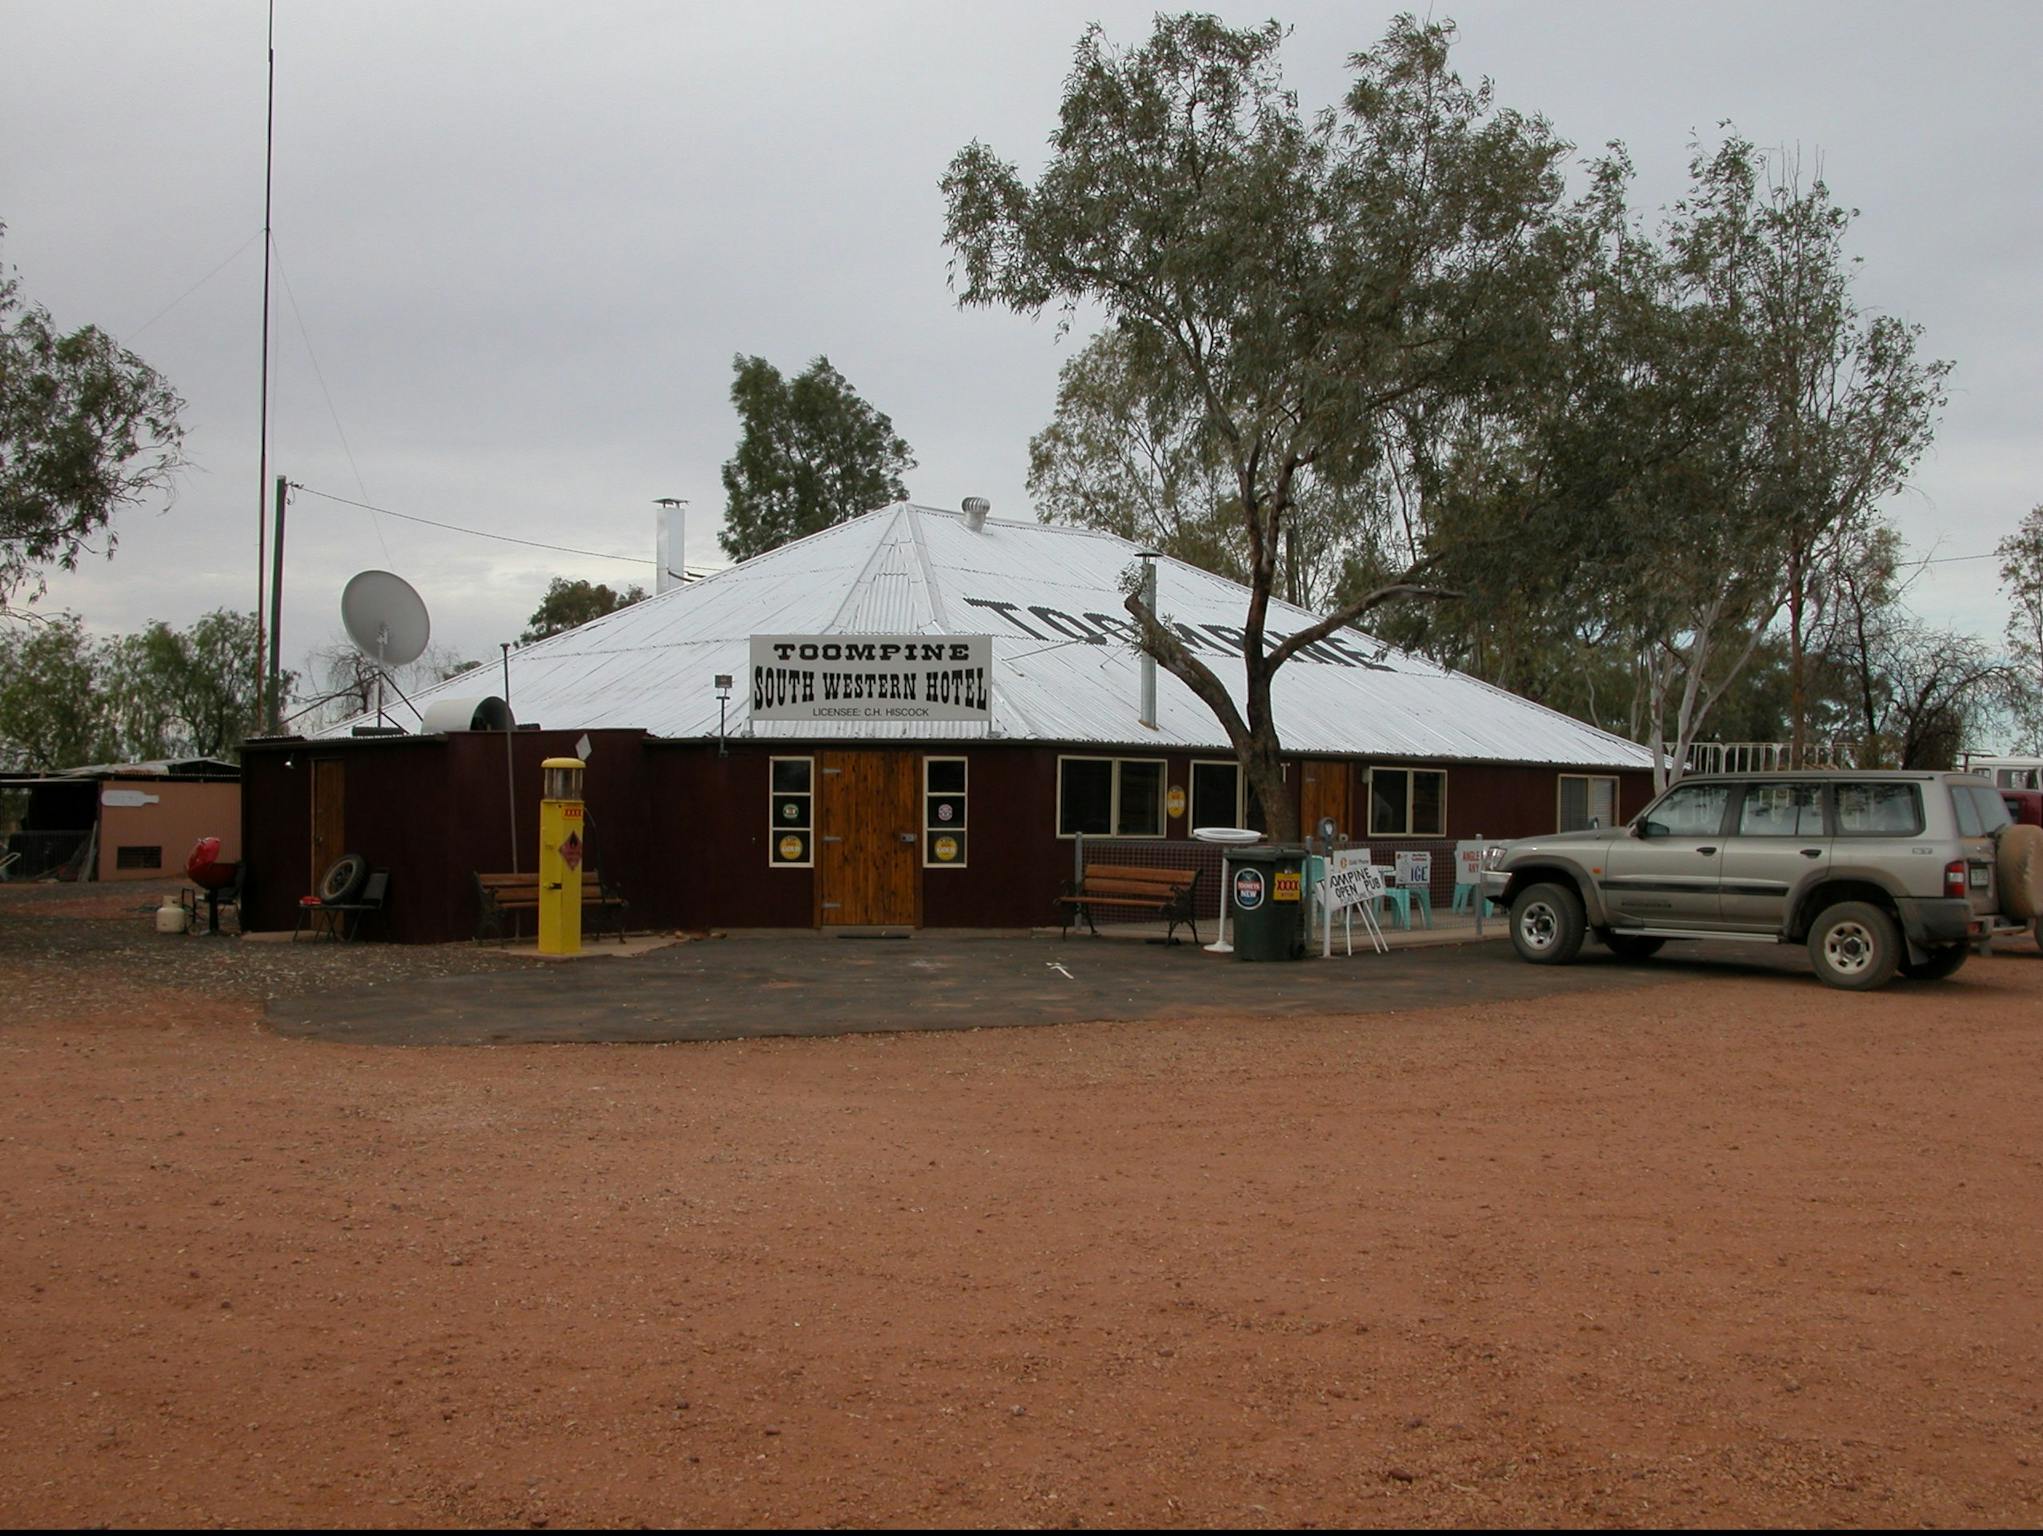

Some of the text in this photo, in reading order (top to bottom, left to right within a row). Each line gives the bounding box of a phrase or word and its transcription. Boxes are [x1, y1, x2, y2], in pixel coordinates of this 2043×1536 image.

[773, 643, 970, 661] TOOMPINE
[754, 665, 988, 711] SOUTH WESTERN HOTEL
[885, 708, 930, 717] HISCOCK
[1277, 879, 1299, 891] XXXX
[1316, 867, 1372, 890] TOMPINE
[1335, 883, 1360, 898] OPEN
[1363, 877, 1382, 891] PUB
[1240, 890, 1258, 898] NEW
